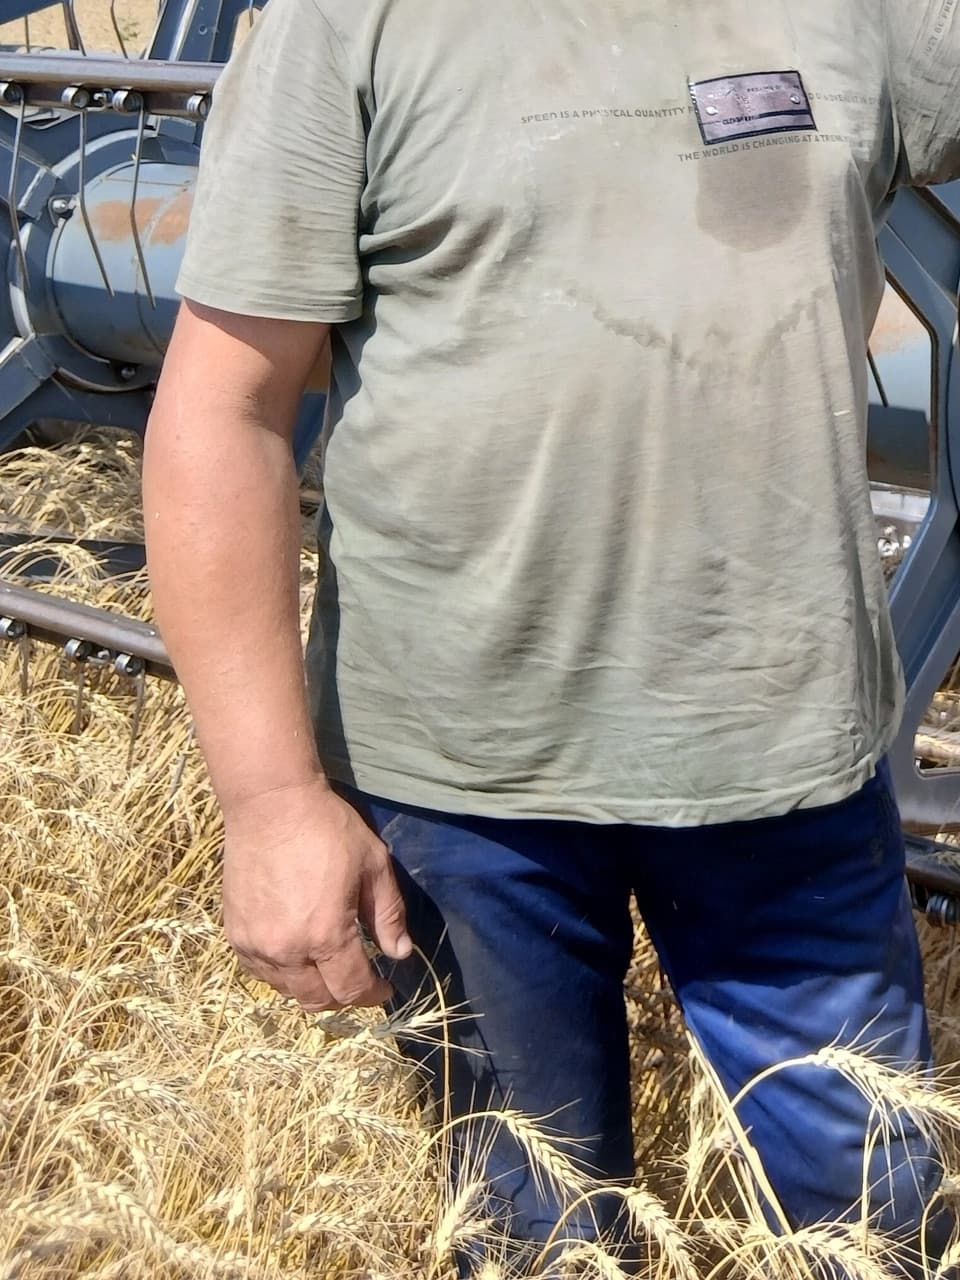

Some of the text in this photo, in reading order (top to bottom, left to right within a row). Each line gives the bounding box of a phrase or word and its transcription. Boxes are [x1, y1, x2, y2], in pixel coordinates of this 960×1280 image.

[521, 112, 557, 124] SPEED
[560, 110, 570, 119] IS
[573, 110, 580, 118] A
[634, 106, 685, 118] QUANTITY
[678, 151, 700, 161] THE
[702, 143, 739, 158] WORLD
[742, 142, 751, 151] IS
[753, 135, 800, 150] CHANGING
[802, 134, 812, 143] AT
